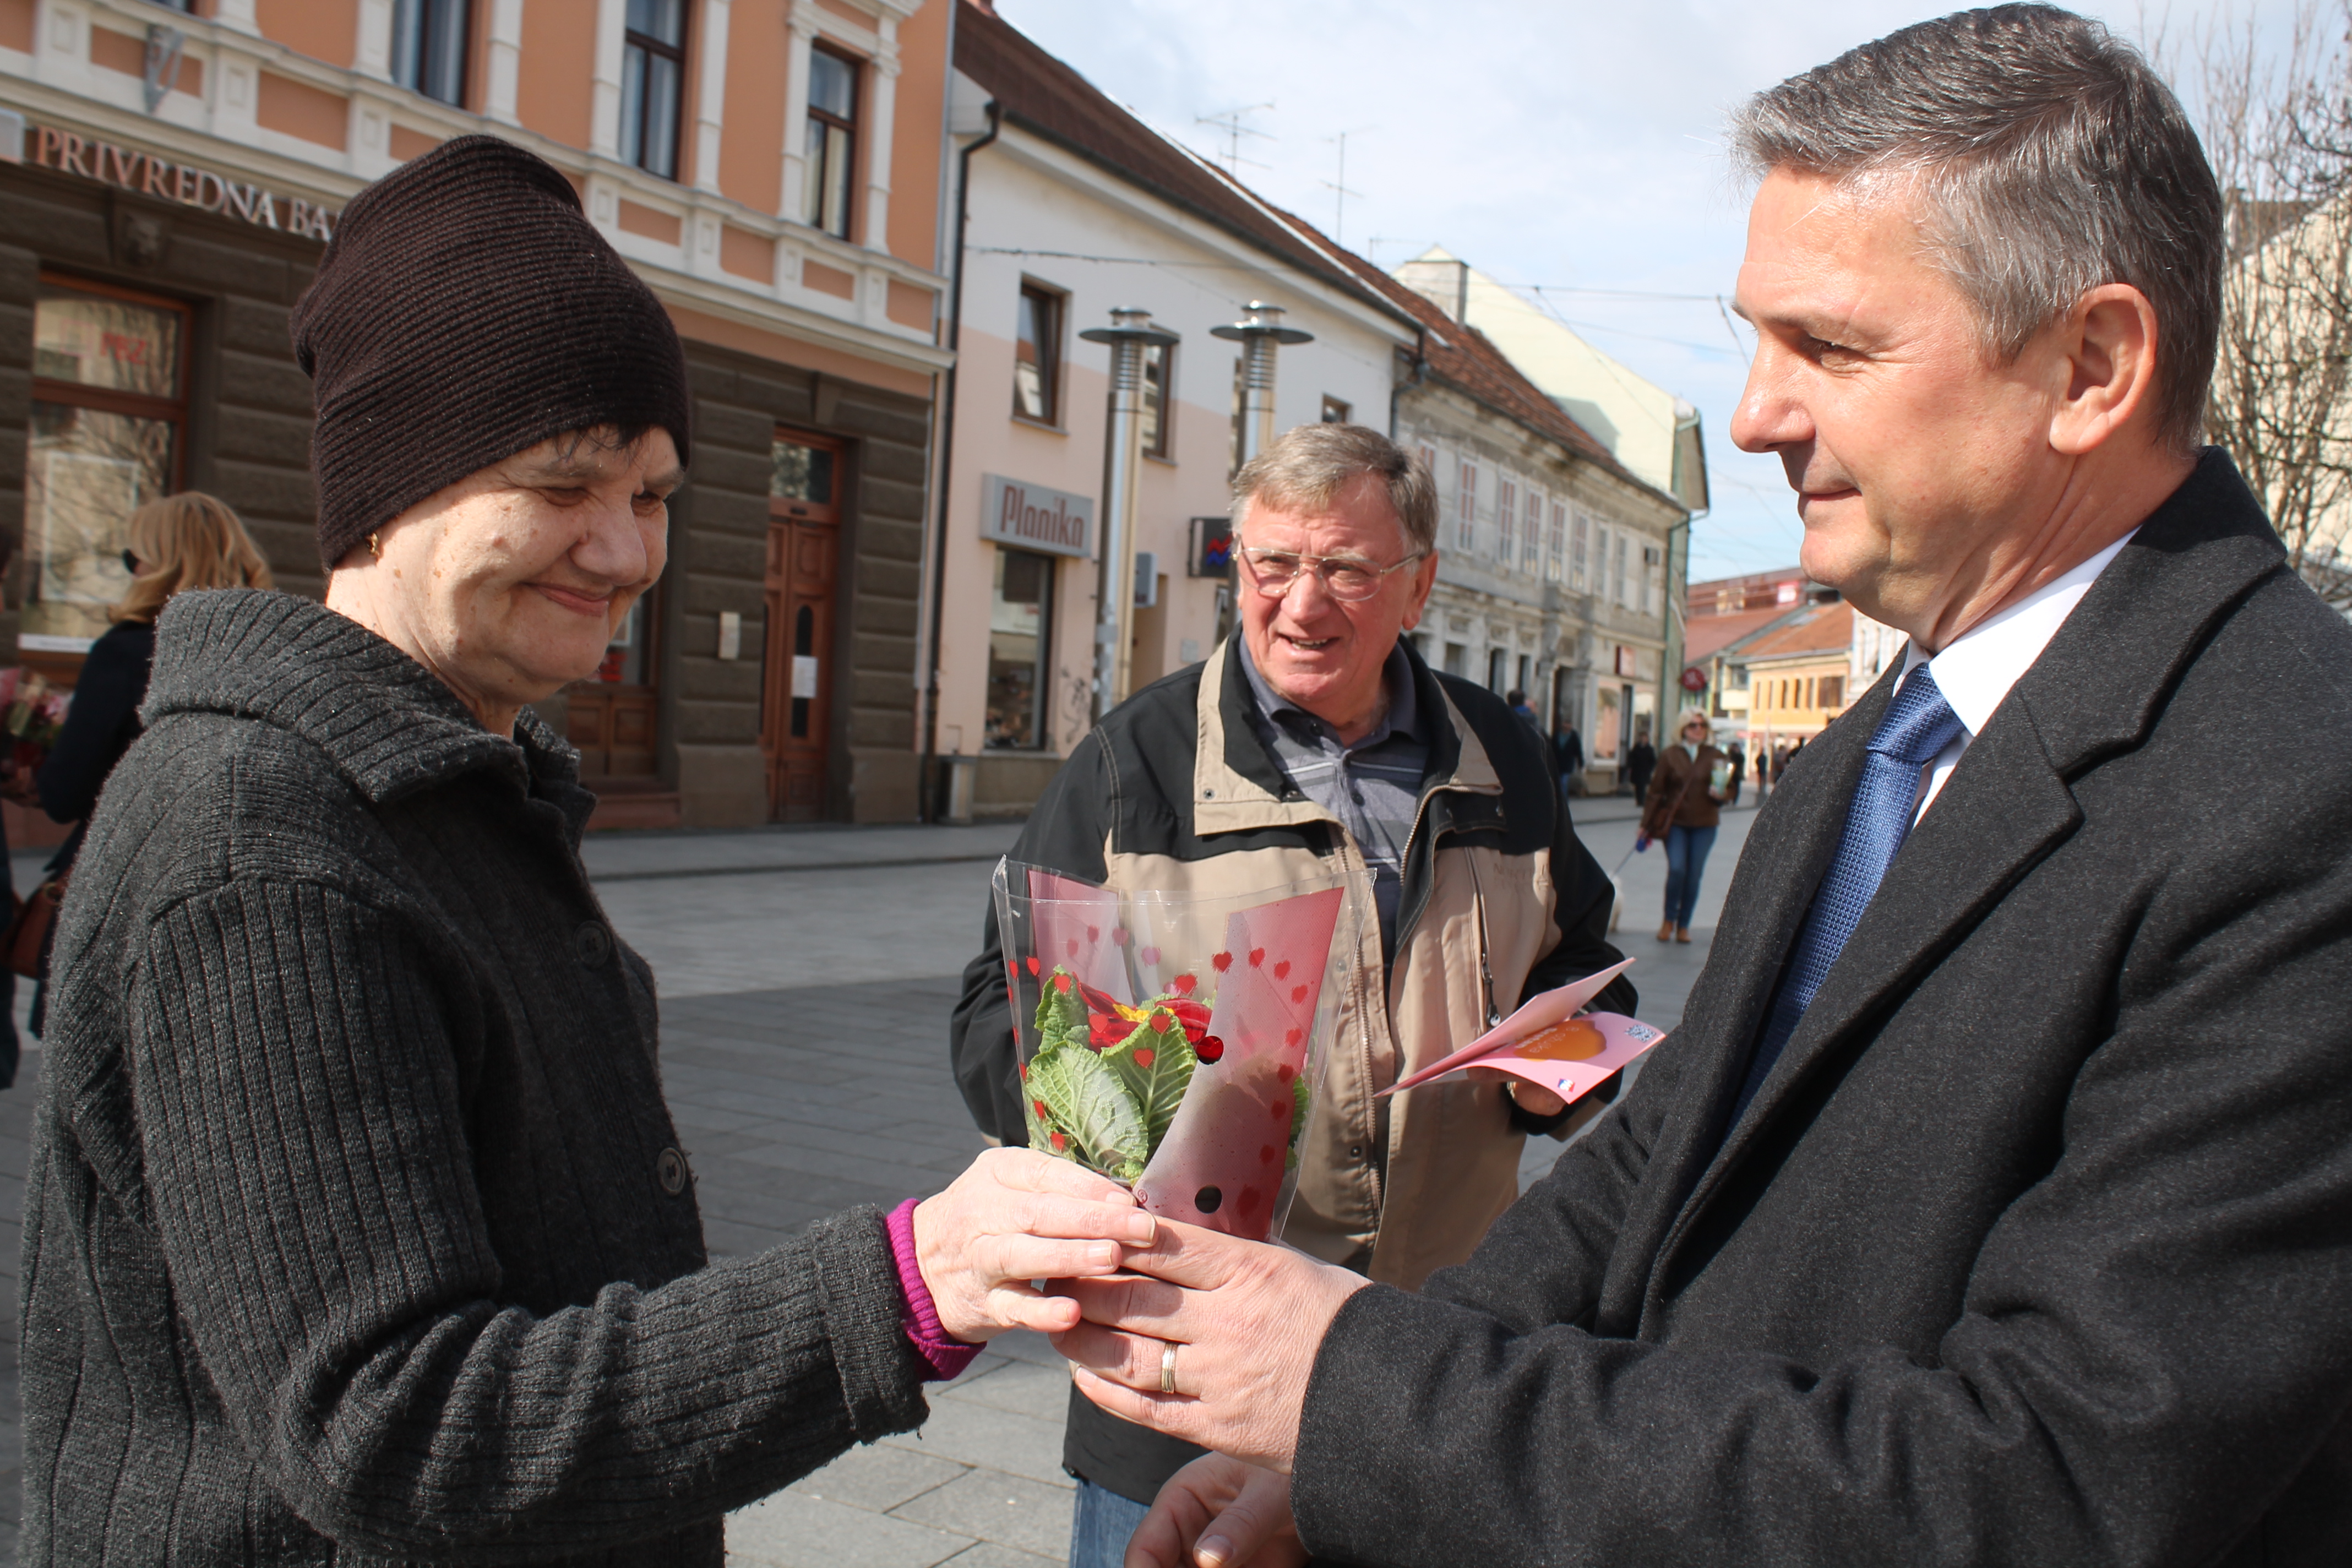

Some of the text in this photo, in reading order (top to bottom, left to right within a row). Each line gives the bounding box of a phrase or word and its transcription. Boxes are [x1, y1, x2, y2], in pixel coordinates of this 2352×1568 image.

[36, 124, 340, 242] PRIVREDNA BA
[999, 484, 1085, 548] Planika
